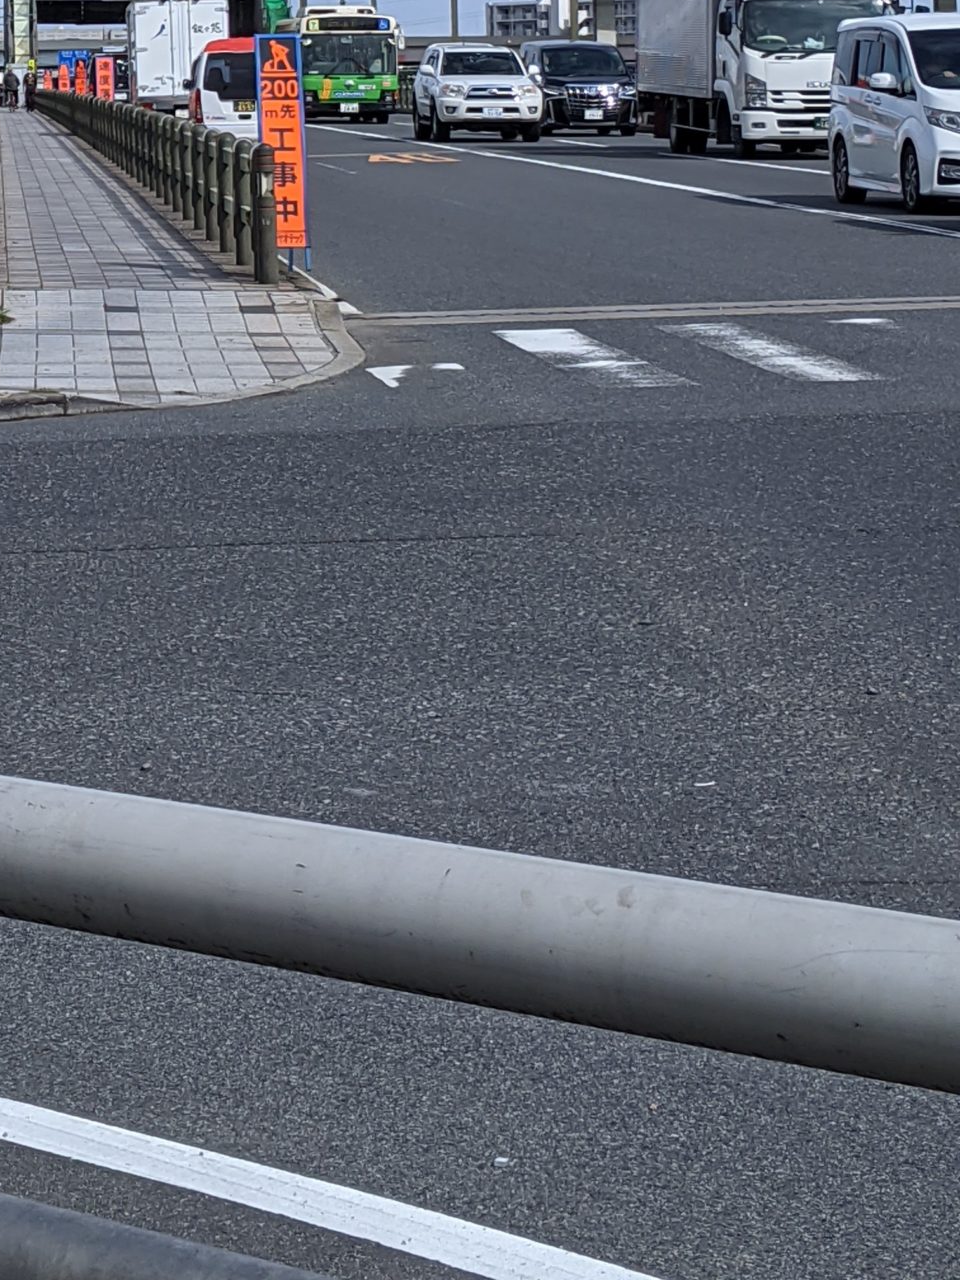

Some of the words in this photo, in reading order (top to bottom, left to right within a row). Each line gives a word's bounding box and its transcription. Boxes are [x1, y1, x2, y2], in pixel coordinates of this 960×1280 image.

[261, 79, 298, 98] 200
[269, 127, 298, 223] 工事中
